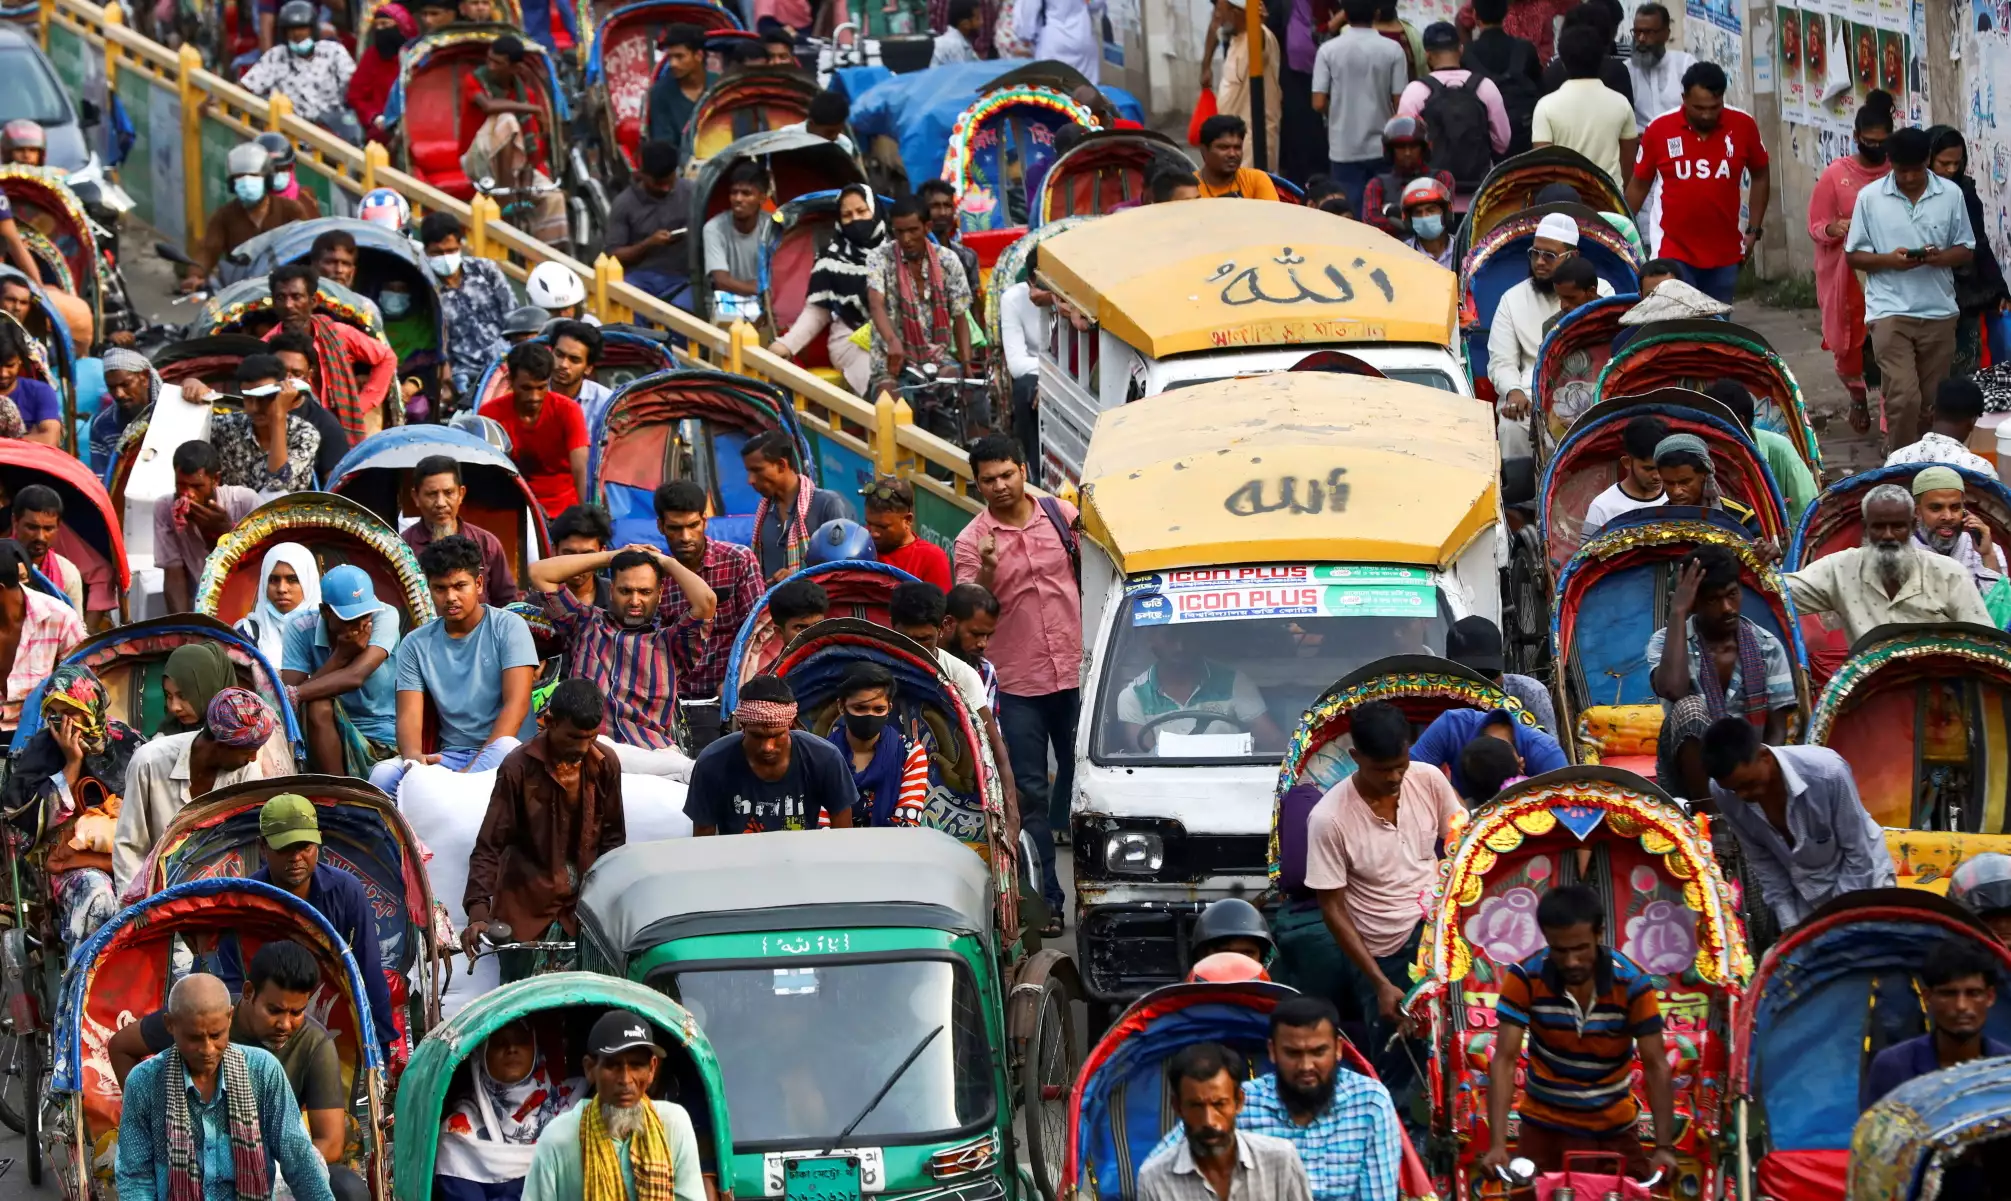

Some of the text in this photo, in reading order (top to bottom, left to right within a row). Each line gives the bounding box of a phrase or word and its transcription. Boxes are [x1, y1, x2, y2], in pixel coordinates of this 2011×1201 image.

[1675, 159, 1730, 180] USA
[1169, 566, 1307, 582] ICON PLUS
[1179, 589, 1317, 611] ICON PLUS
